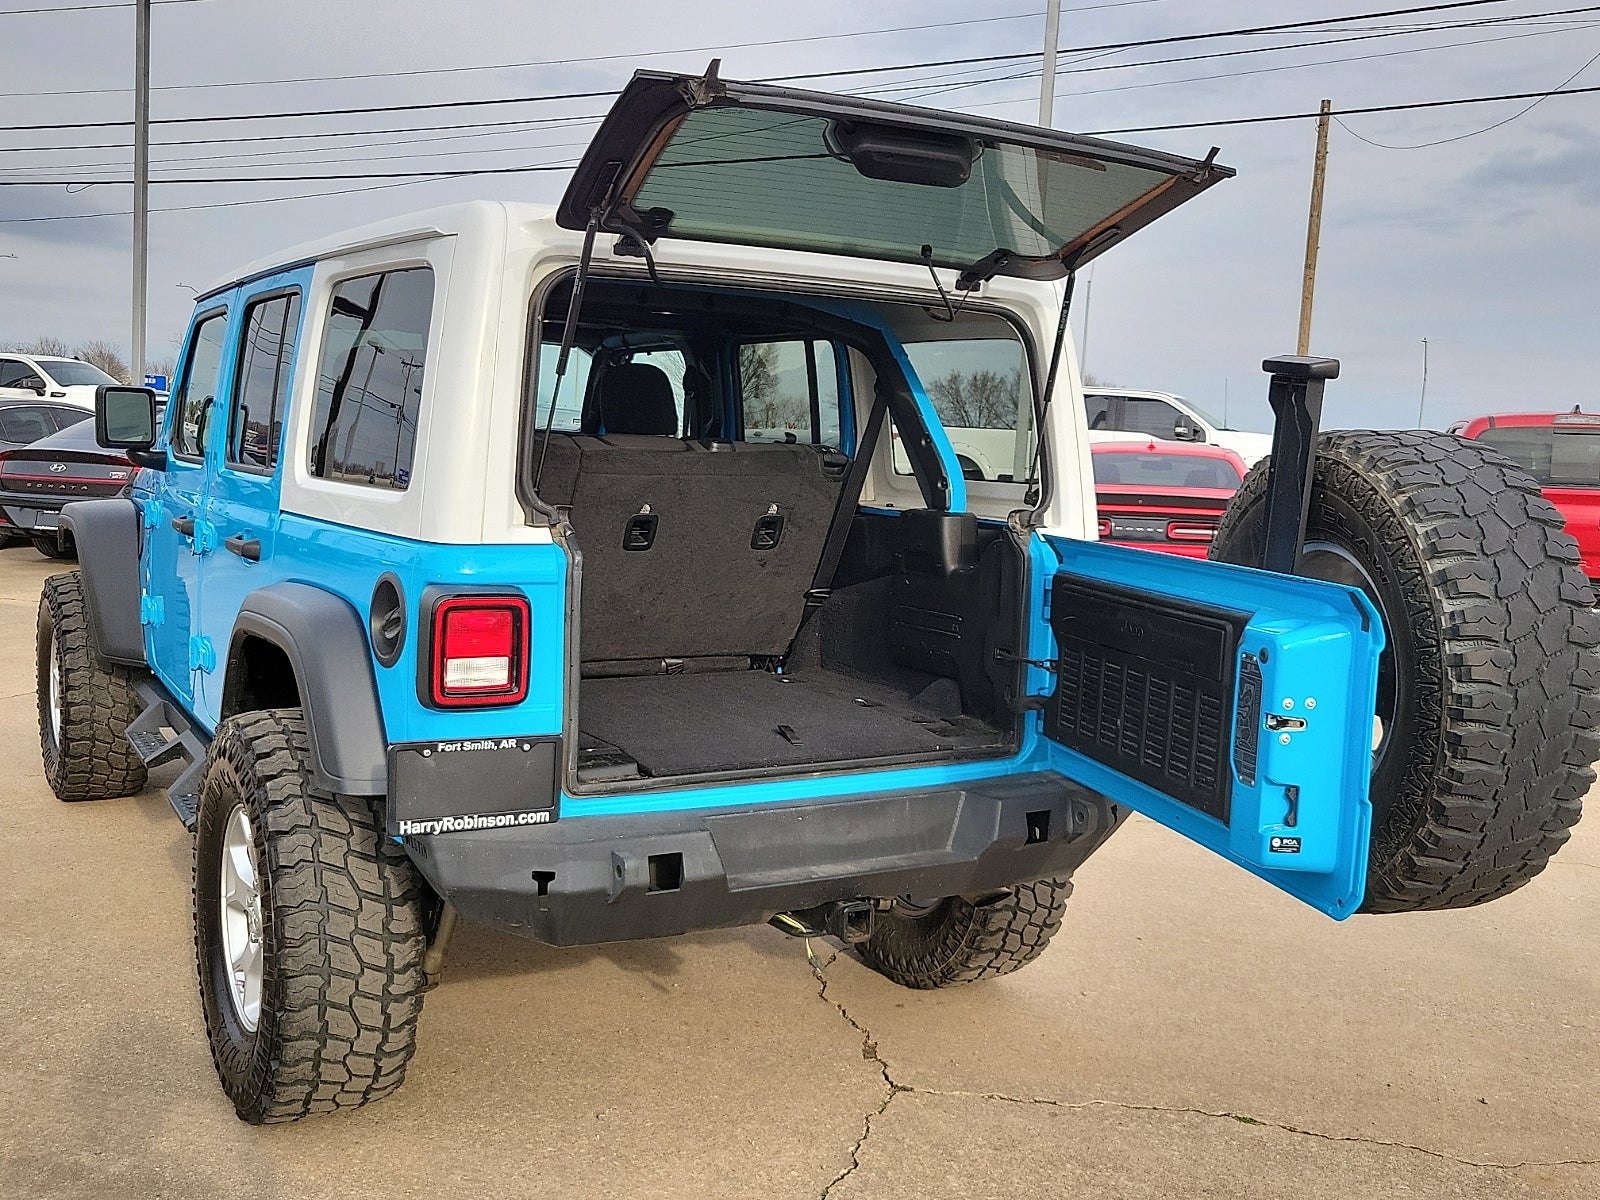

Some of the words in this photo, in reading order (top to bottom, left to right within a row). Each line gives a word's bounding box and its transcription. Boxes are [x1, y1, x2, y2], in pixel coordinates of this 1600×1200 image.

[26, 482, 88, 490] SONATA
[437, 742, 462, 752] Fort
[463, 740, 498, 751] Smith,
[499, 739, 516, 748] AR
[399, 811, 550, 836] HarryRobinson.com
